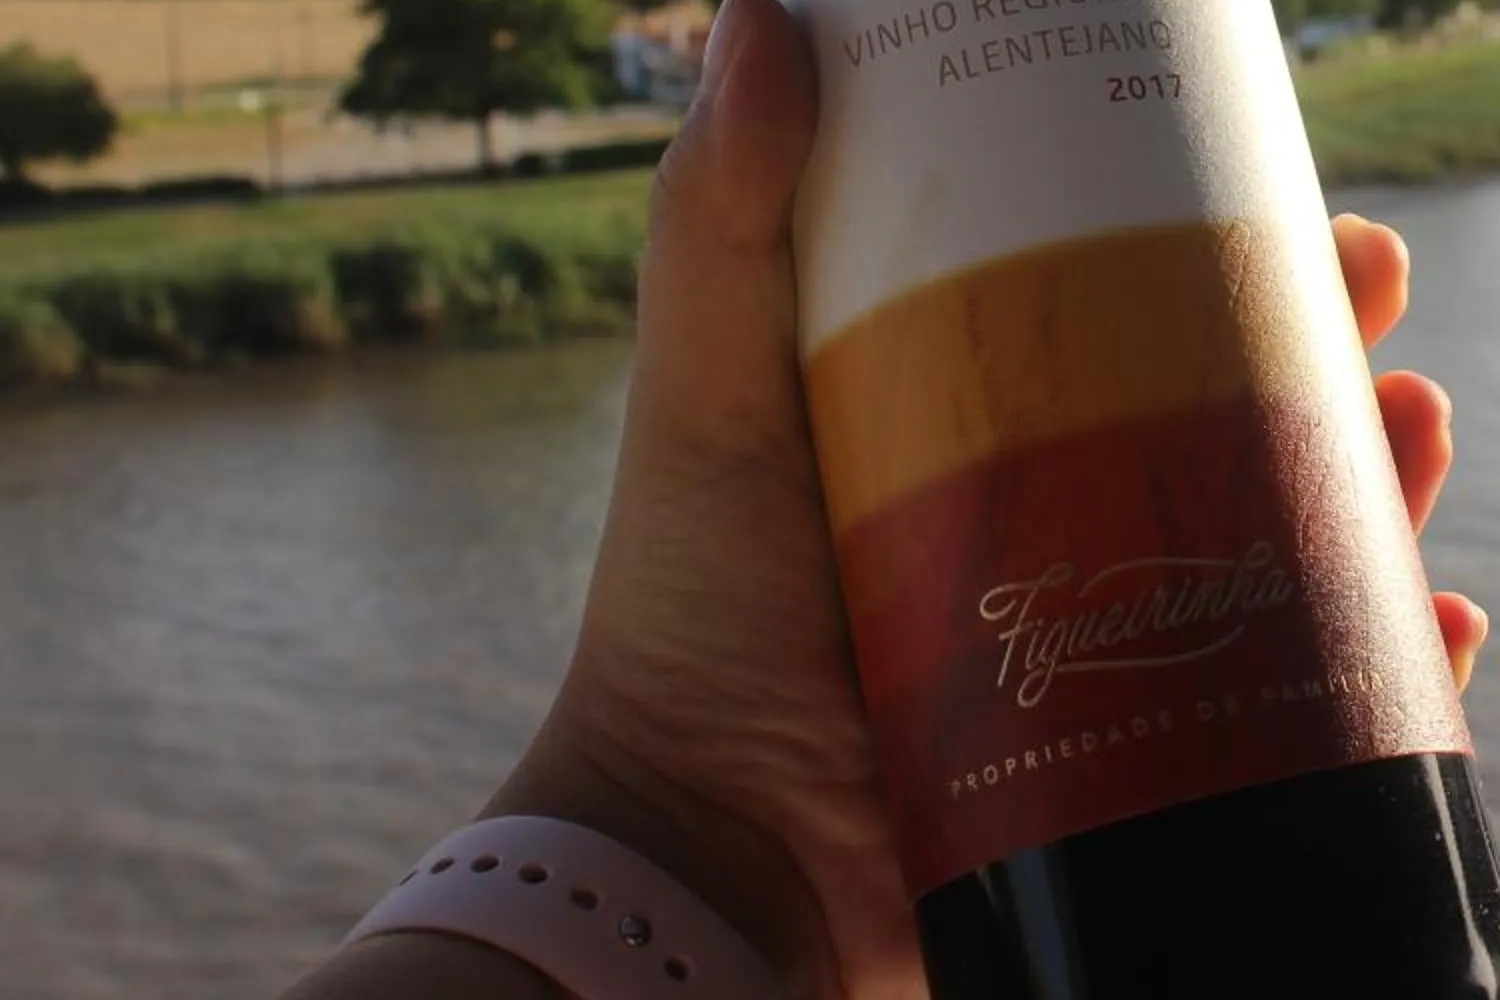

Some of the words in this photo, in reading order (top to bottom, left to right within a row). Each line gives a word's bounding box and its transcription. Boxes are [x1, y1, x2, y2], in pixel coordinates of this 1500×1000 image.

[843, 1, 958, 69] VINHO
[937, 20, 1172, 87] ALENTEJANO
[1108, 73, 1182, 102] 2017
[979, 541, 1295, 708] Figueirinha
[945, 711, 1175, 800] PROPRIEDADE
[1196, 692, 1241, 722] DE
